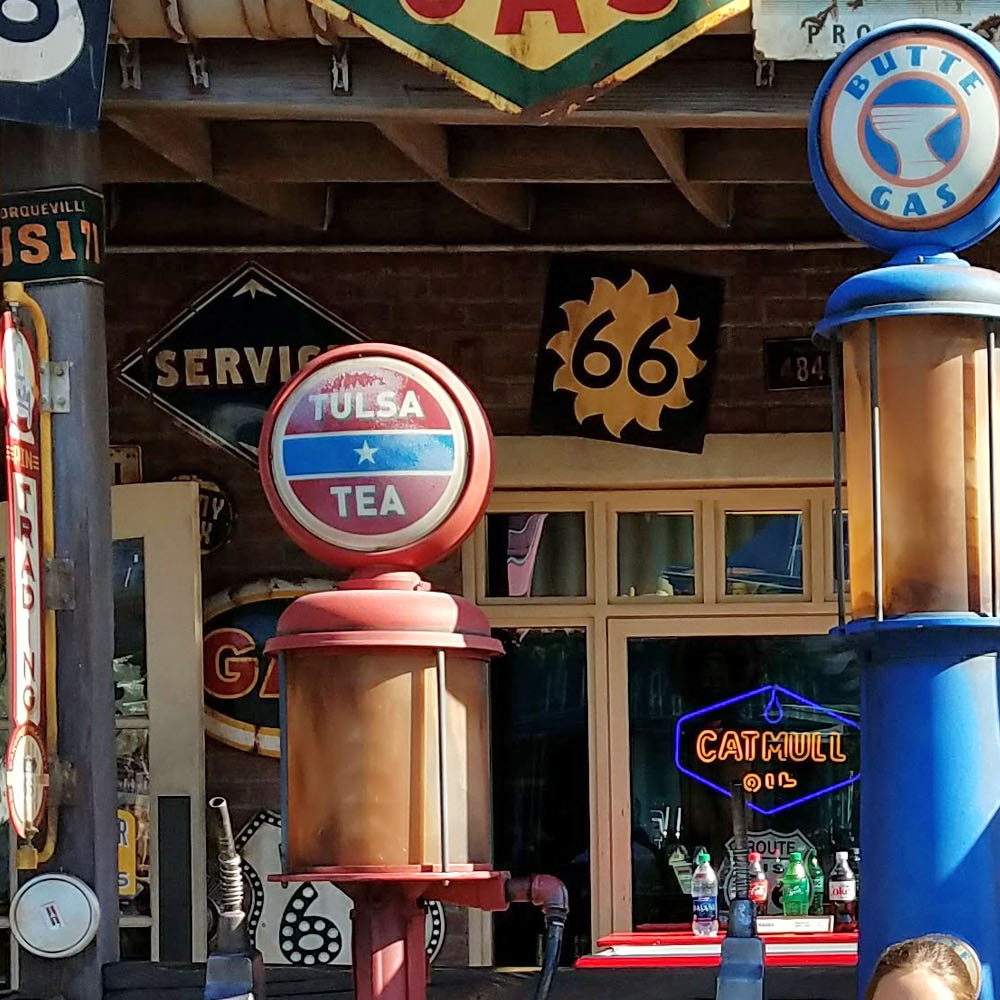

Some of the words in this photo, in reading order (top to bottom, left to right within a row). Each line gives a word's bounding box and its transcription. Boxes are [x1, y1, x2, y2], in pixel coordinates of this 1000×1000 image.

[844, 45, 984, 101] BUTTE
[870, 183, 957, 217] GAS
[571, 309, 679, 398] 66
[309, 390, 425, 422] TULSA
[330, 484, 407, 518] TEA
[19, 481, 36, 712] TRADING
[695, 729, 848, 763] CATMULL
[742, 771, 798, 793] OIL
